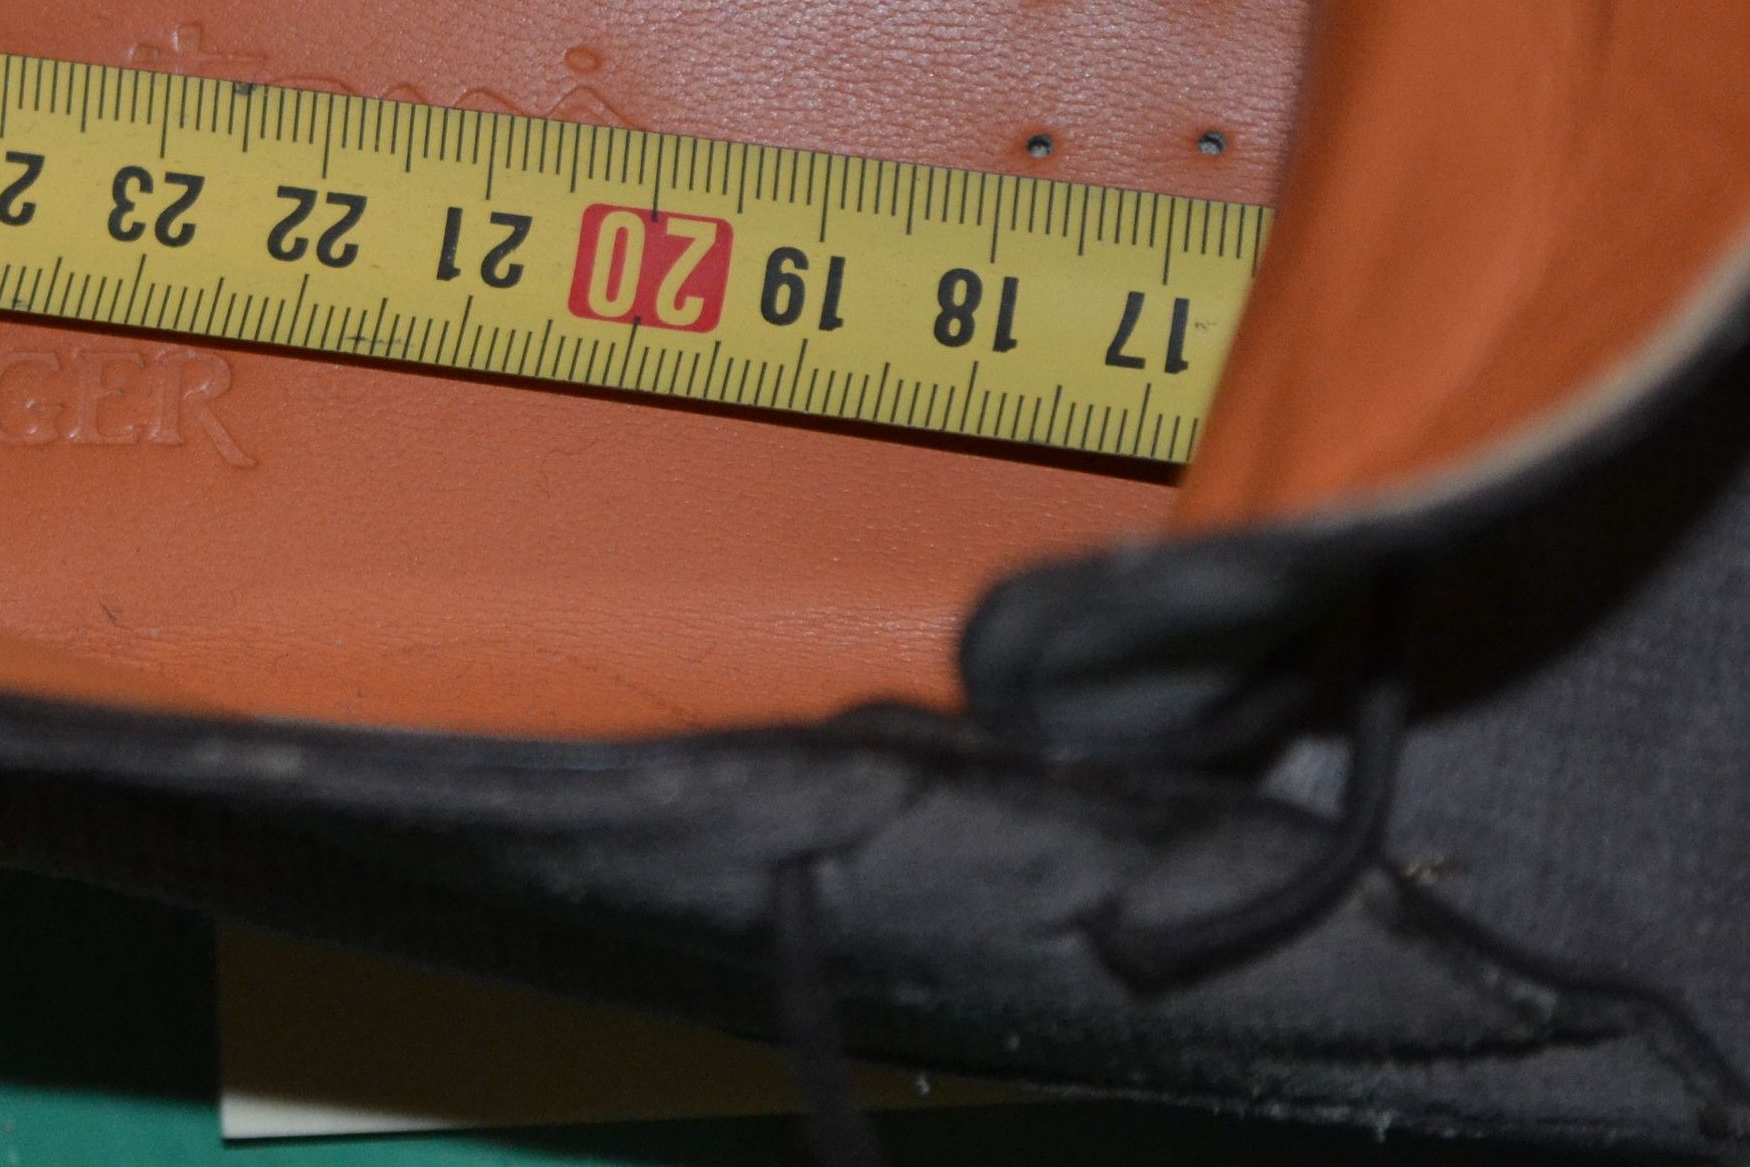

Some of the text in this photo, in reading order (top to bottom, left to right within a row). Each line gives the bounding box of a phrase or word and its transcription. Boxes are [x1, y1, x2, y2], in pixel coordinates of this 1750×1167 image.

[107, 165, 205, 248] 23
[266, 185, 368, 269] 22
[436, 206, 533, 289] 21
[586, 210, 717, 327] 20
[760, 246, 846, 332] 19
[933, 267, 1020, 353] 18
[1104, 291, 1191, 375] 17
